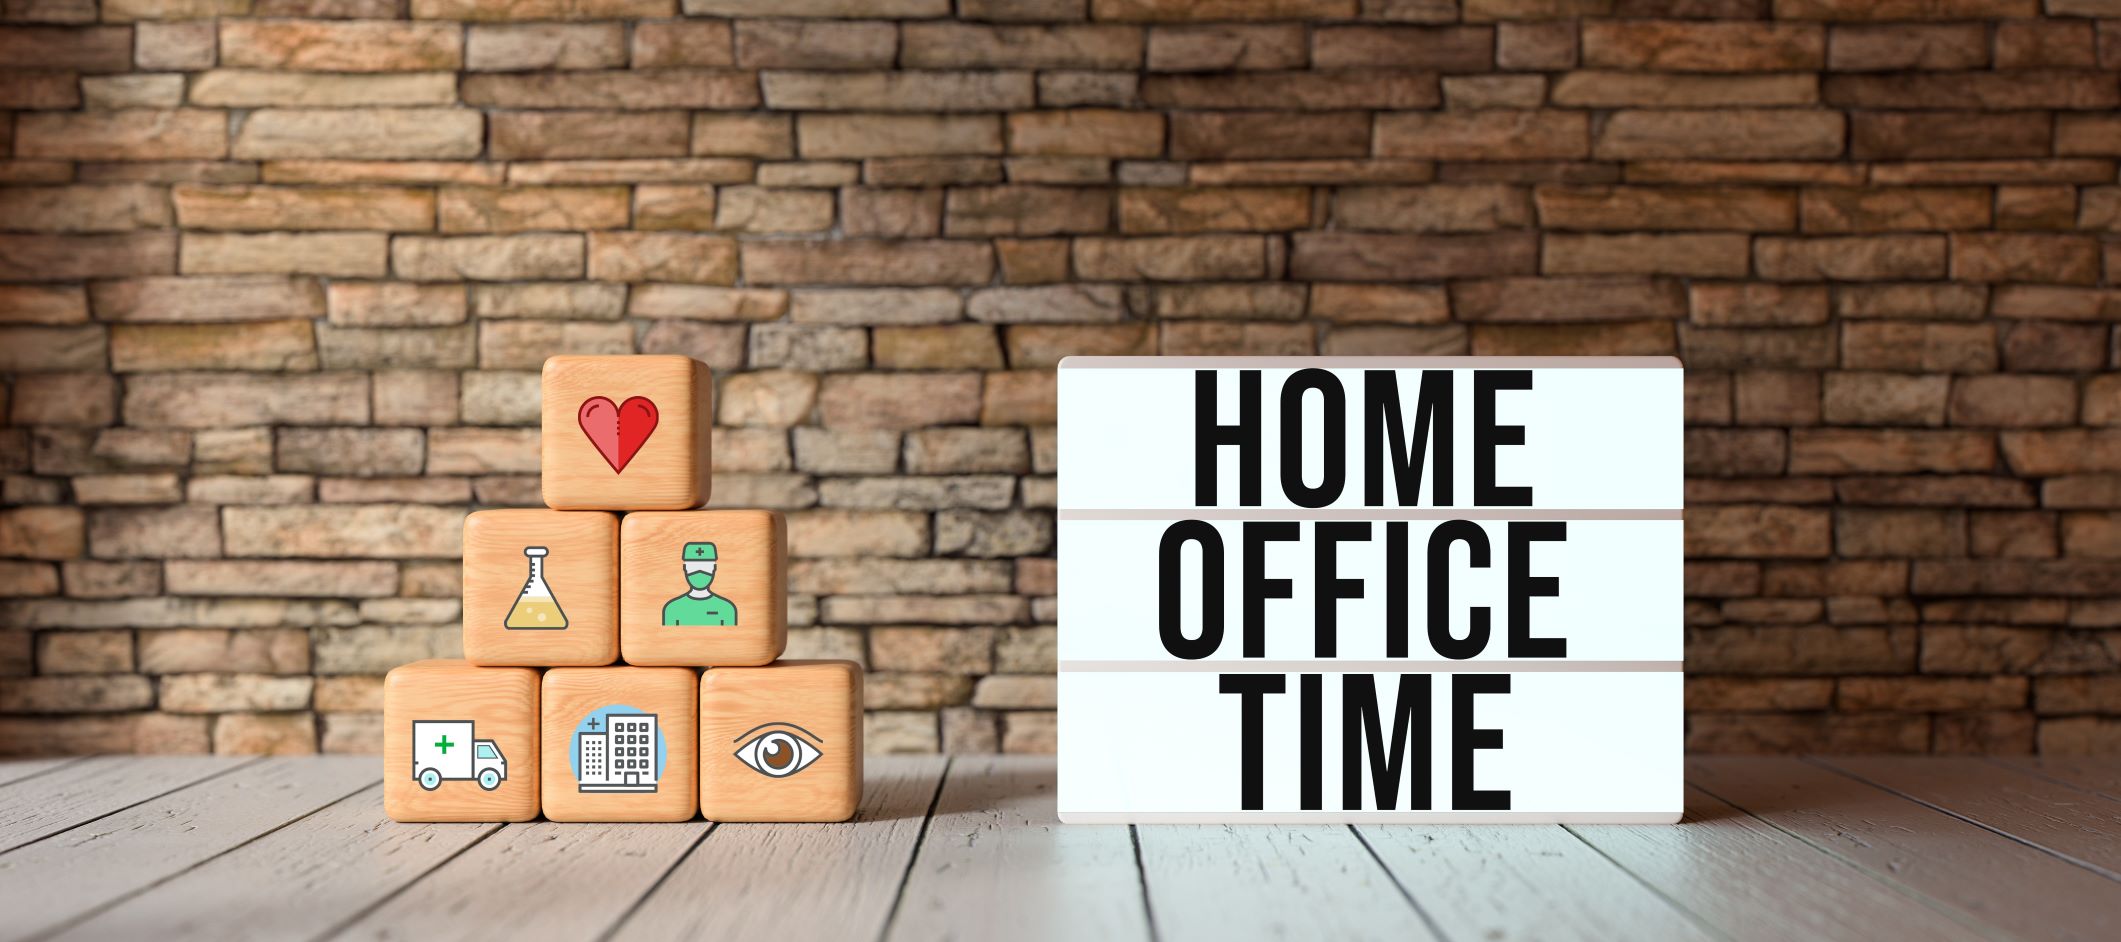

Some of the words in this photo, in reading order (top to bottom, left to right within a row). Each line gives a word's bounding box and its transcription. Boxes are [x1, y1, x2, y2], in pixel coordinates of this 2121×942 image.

[1195, 368, 1533, 508] HOME
[1158, 519, 1567, 660] OFFICE
[1219, 673, 1511, 811] TIME
